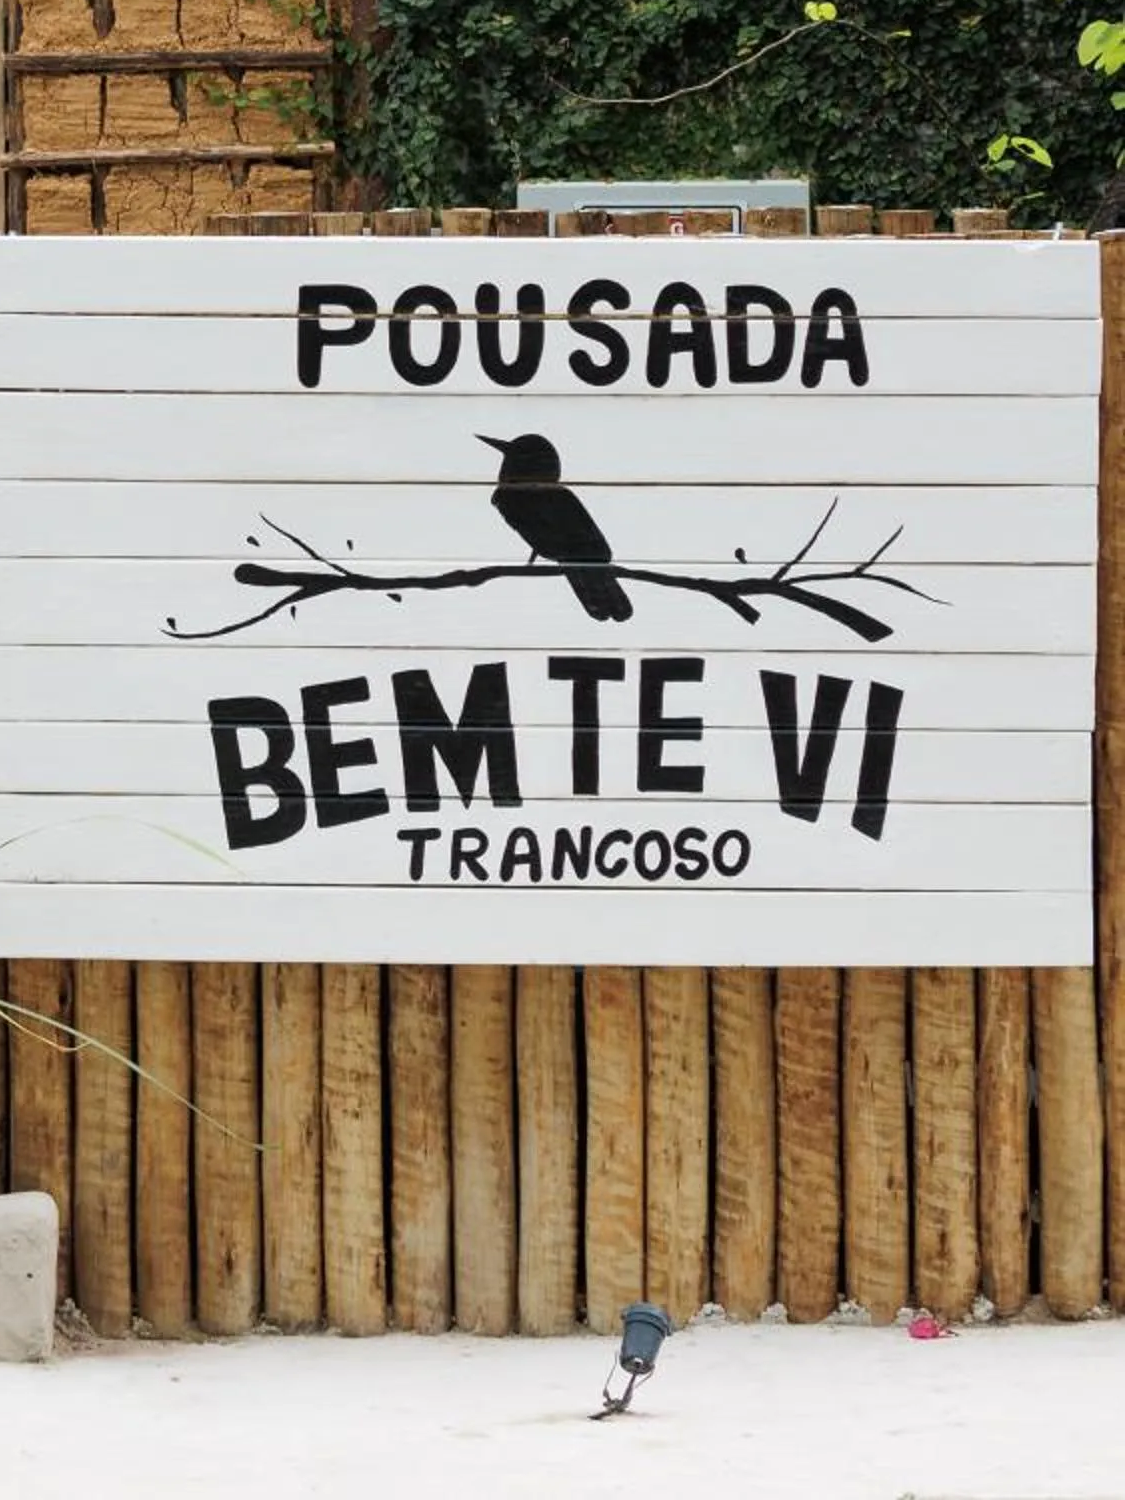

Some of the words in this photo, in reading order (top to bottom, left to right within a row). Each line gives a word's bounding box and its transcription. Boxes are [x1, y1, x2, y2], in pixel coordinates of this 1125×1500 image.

[295, 280, 869, 389] POUSADA
[208, 662, 524, 850] BEM
[548, 657, 705, 796] TE
[761, 671, 904, 841] VI
[397, 827, 750, 882] TRANCOSO
